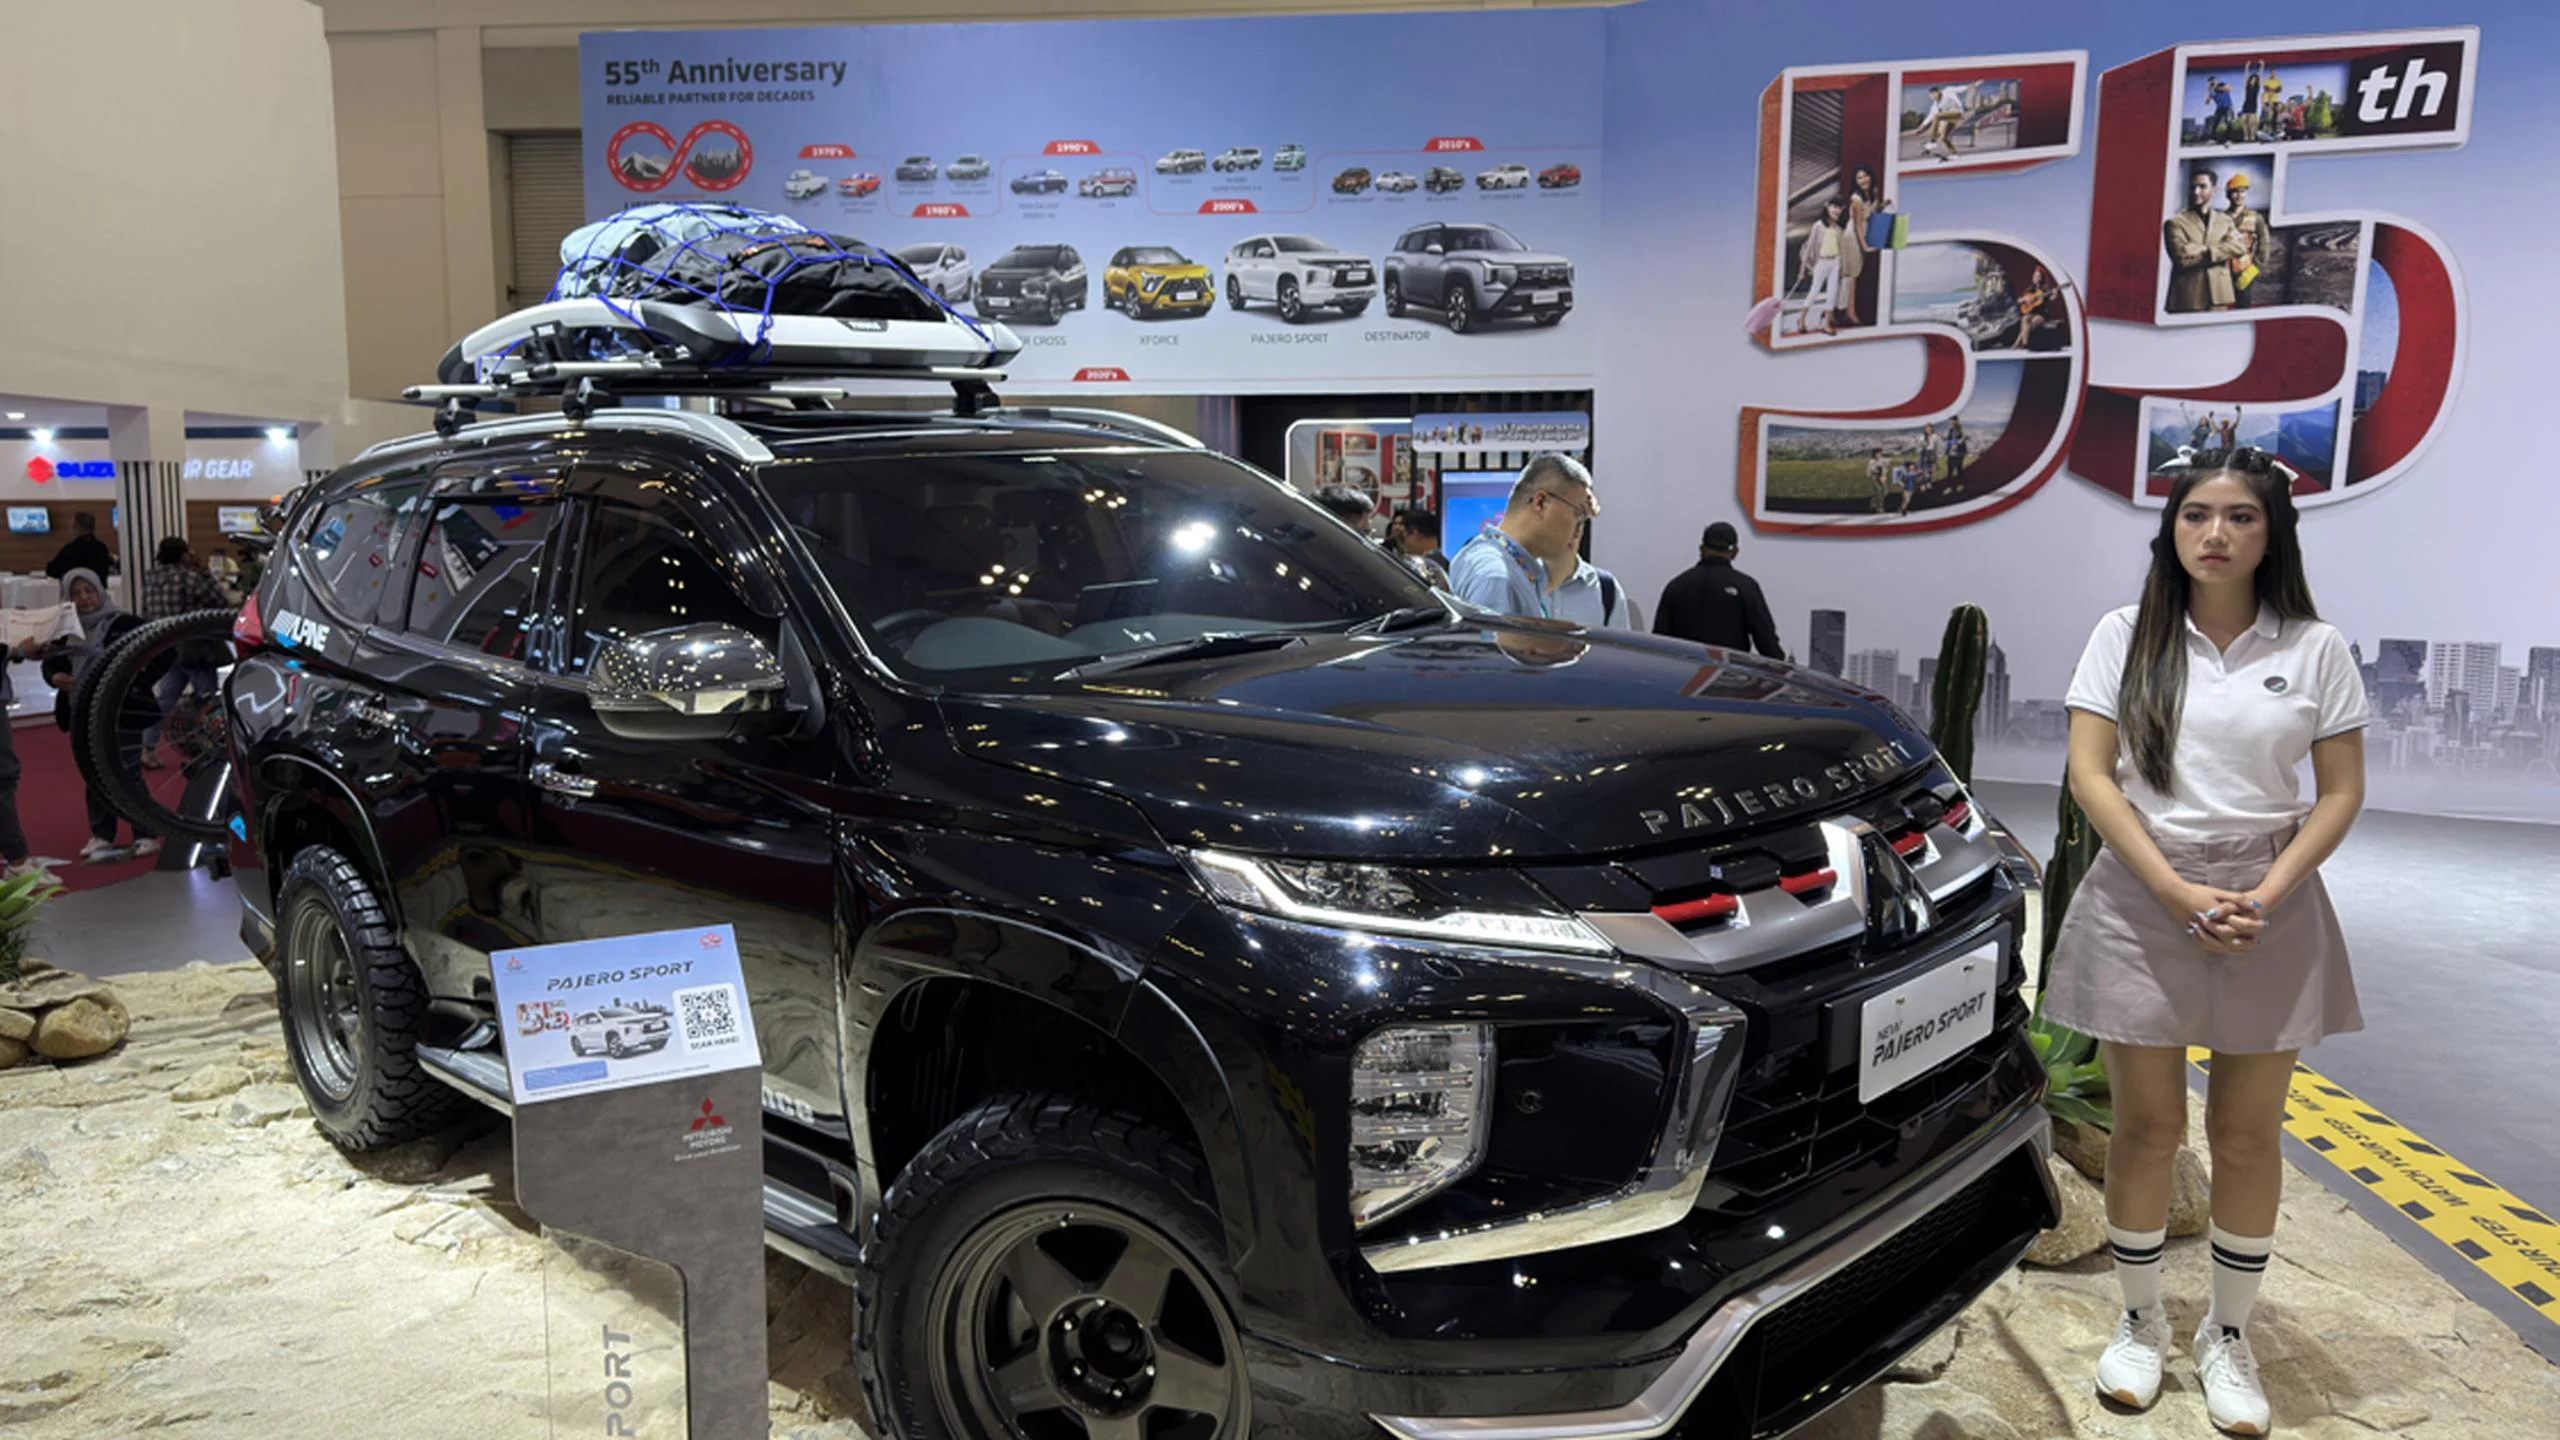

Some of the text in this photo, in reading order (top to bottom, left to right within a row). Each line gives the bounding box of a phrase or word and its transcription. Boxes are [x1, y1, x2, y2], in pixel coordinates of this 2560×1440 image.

[605, 58, 847, 87] 55th Anniversary
[606, 89, 815, 105] RELIABLE PARTNER FOR DECADES
[1033, 335, 1068, 346] CROSS
[1139, 335, 1179, 346] XFORCE
[1251, 333, 1328, 344] PAJERO SPORT
[1364, 331, 1431, 342] DESTINATOR
[56, 461, 115, 478] SUZ
[205, 458, 254, 479] GEAR
[1640, 741, 1912, 835] PAJERO SPORT
[546, 960, 695, 992] PAJERO SPORT
[1872, 991, 1987, 1067] PAJERO SPORT
[2323, 1117, 2371, 1140] STEP
[2359, 1141, 2411, 1168] YOUR
[2399, 1169, 2470, 1207] WATCH
[2470, 1215, 2531, 1247] STEP
[2518, 1249, 2560, 1280] OUR
[602, 1324, 637, 1438] PORT
